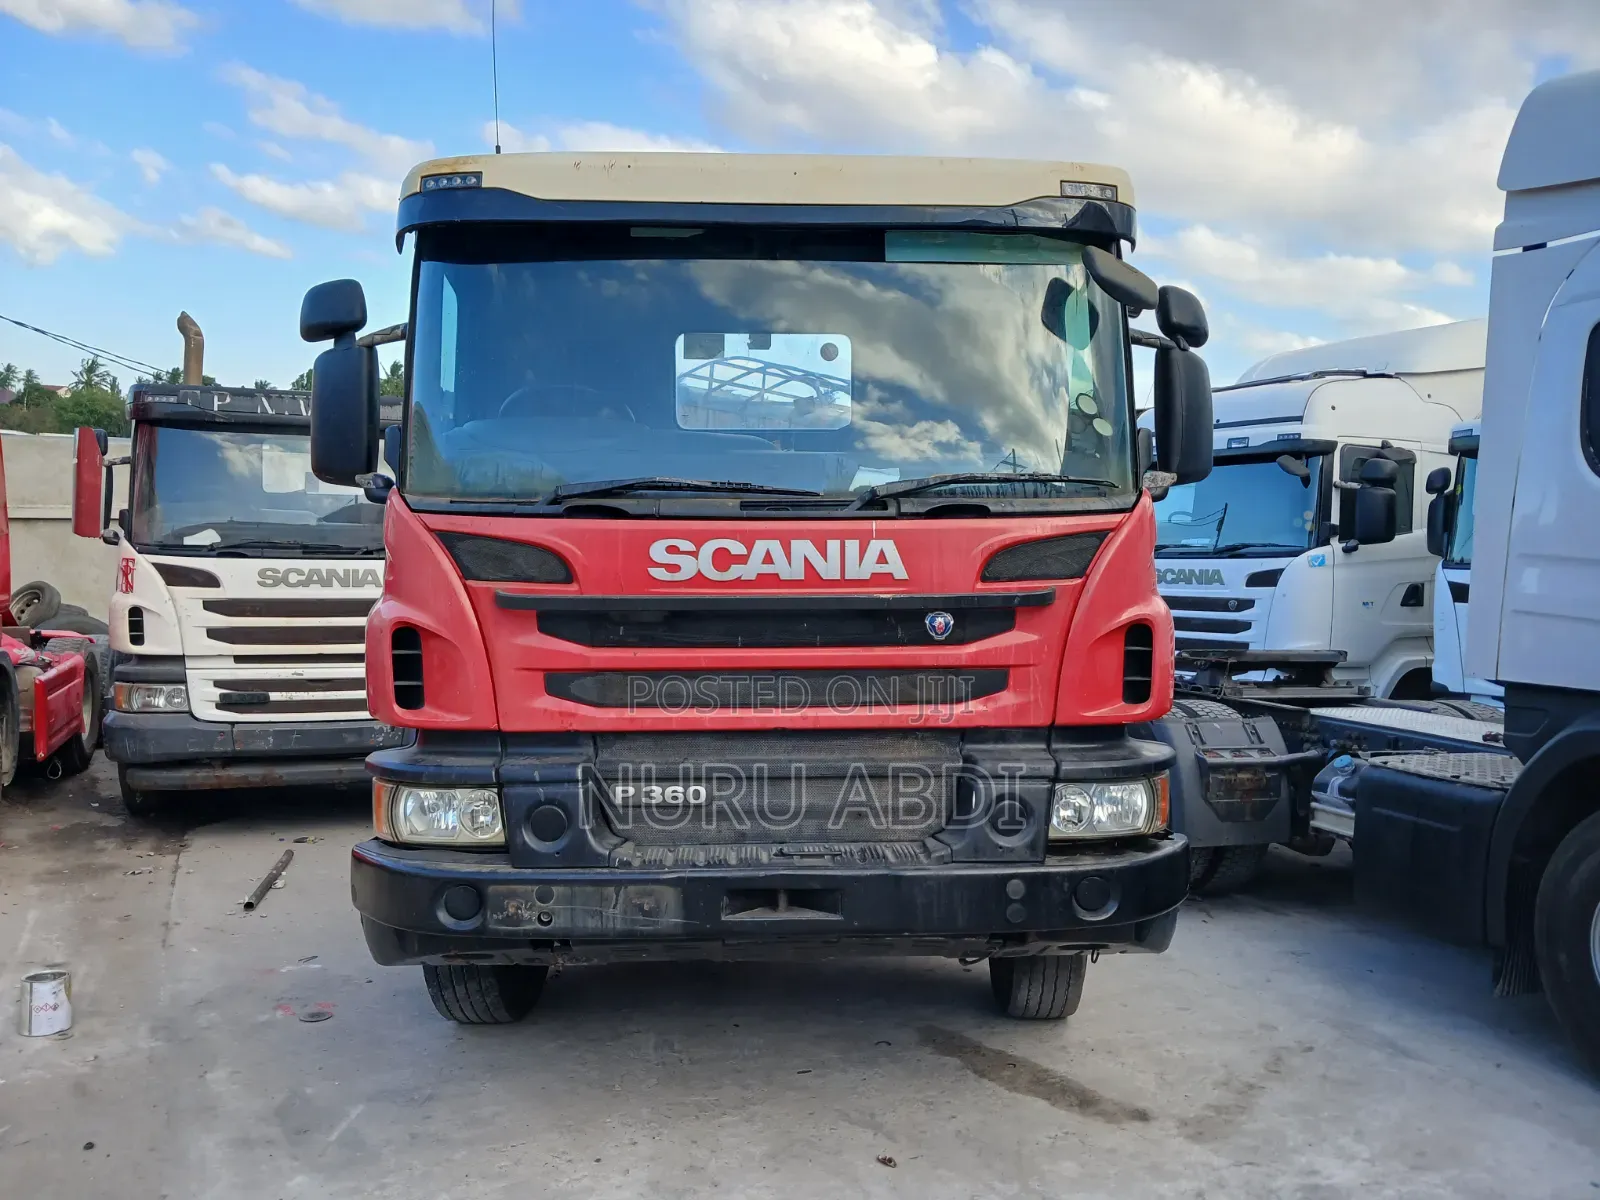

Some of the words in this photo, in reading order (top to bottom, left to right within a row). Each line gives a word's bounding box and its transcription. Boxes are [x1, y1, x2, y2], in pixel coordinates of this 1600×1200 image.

[647, 538, 910, 582] SCANIA
[256, 567, 384, 588] SCANIA
[614, 786, 636, 804] P
[641, 785, 707, 804] 360
